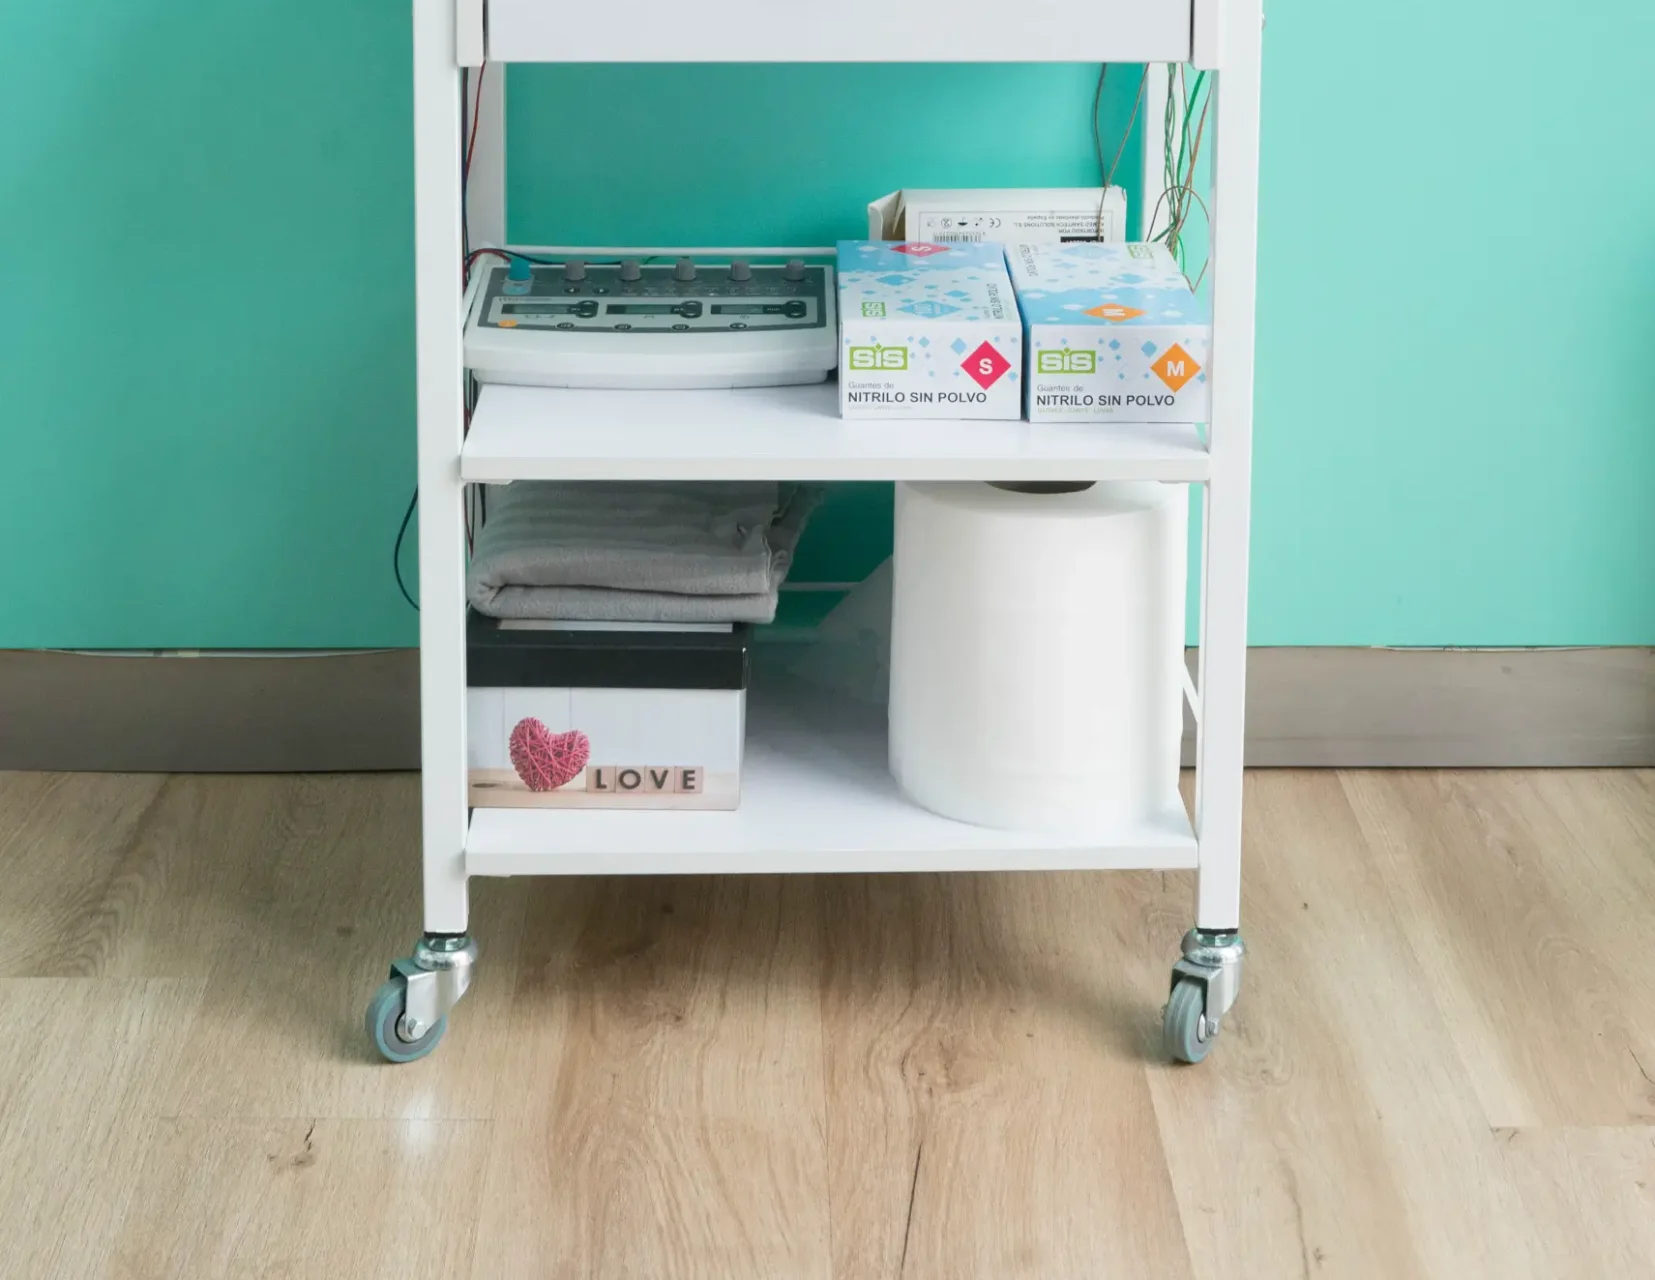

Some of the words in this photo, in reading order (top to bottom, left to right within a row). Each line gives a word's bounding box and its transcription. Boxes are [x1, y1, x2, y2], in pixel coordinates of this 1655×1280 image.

[979, 358, 993, 375] S
[1166, 361, 1184, 377] M
[848, 381, 881, 389] Guantes
[848, 392, 905, 403] NITRILO
[910, 392, 933, 403] SIN
[938, 392, 987, 403] POLVO
[1036, 395, 1094, 406] NITRILO
[1098, 395, 1121, 406] SIN
[1126, 395, 1175, 406] POLVO
[595, 768, 696, 790] LOVE
